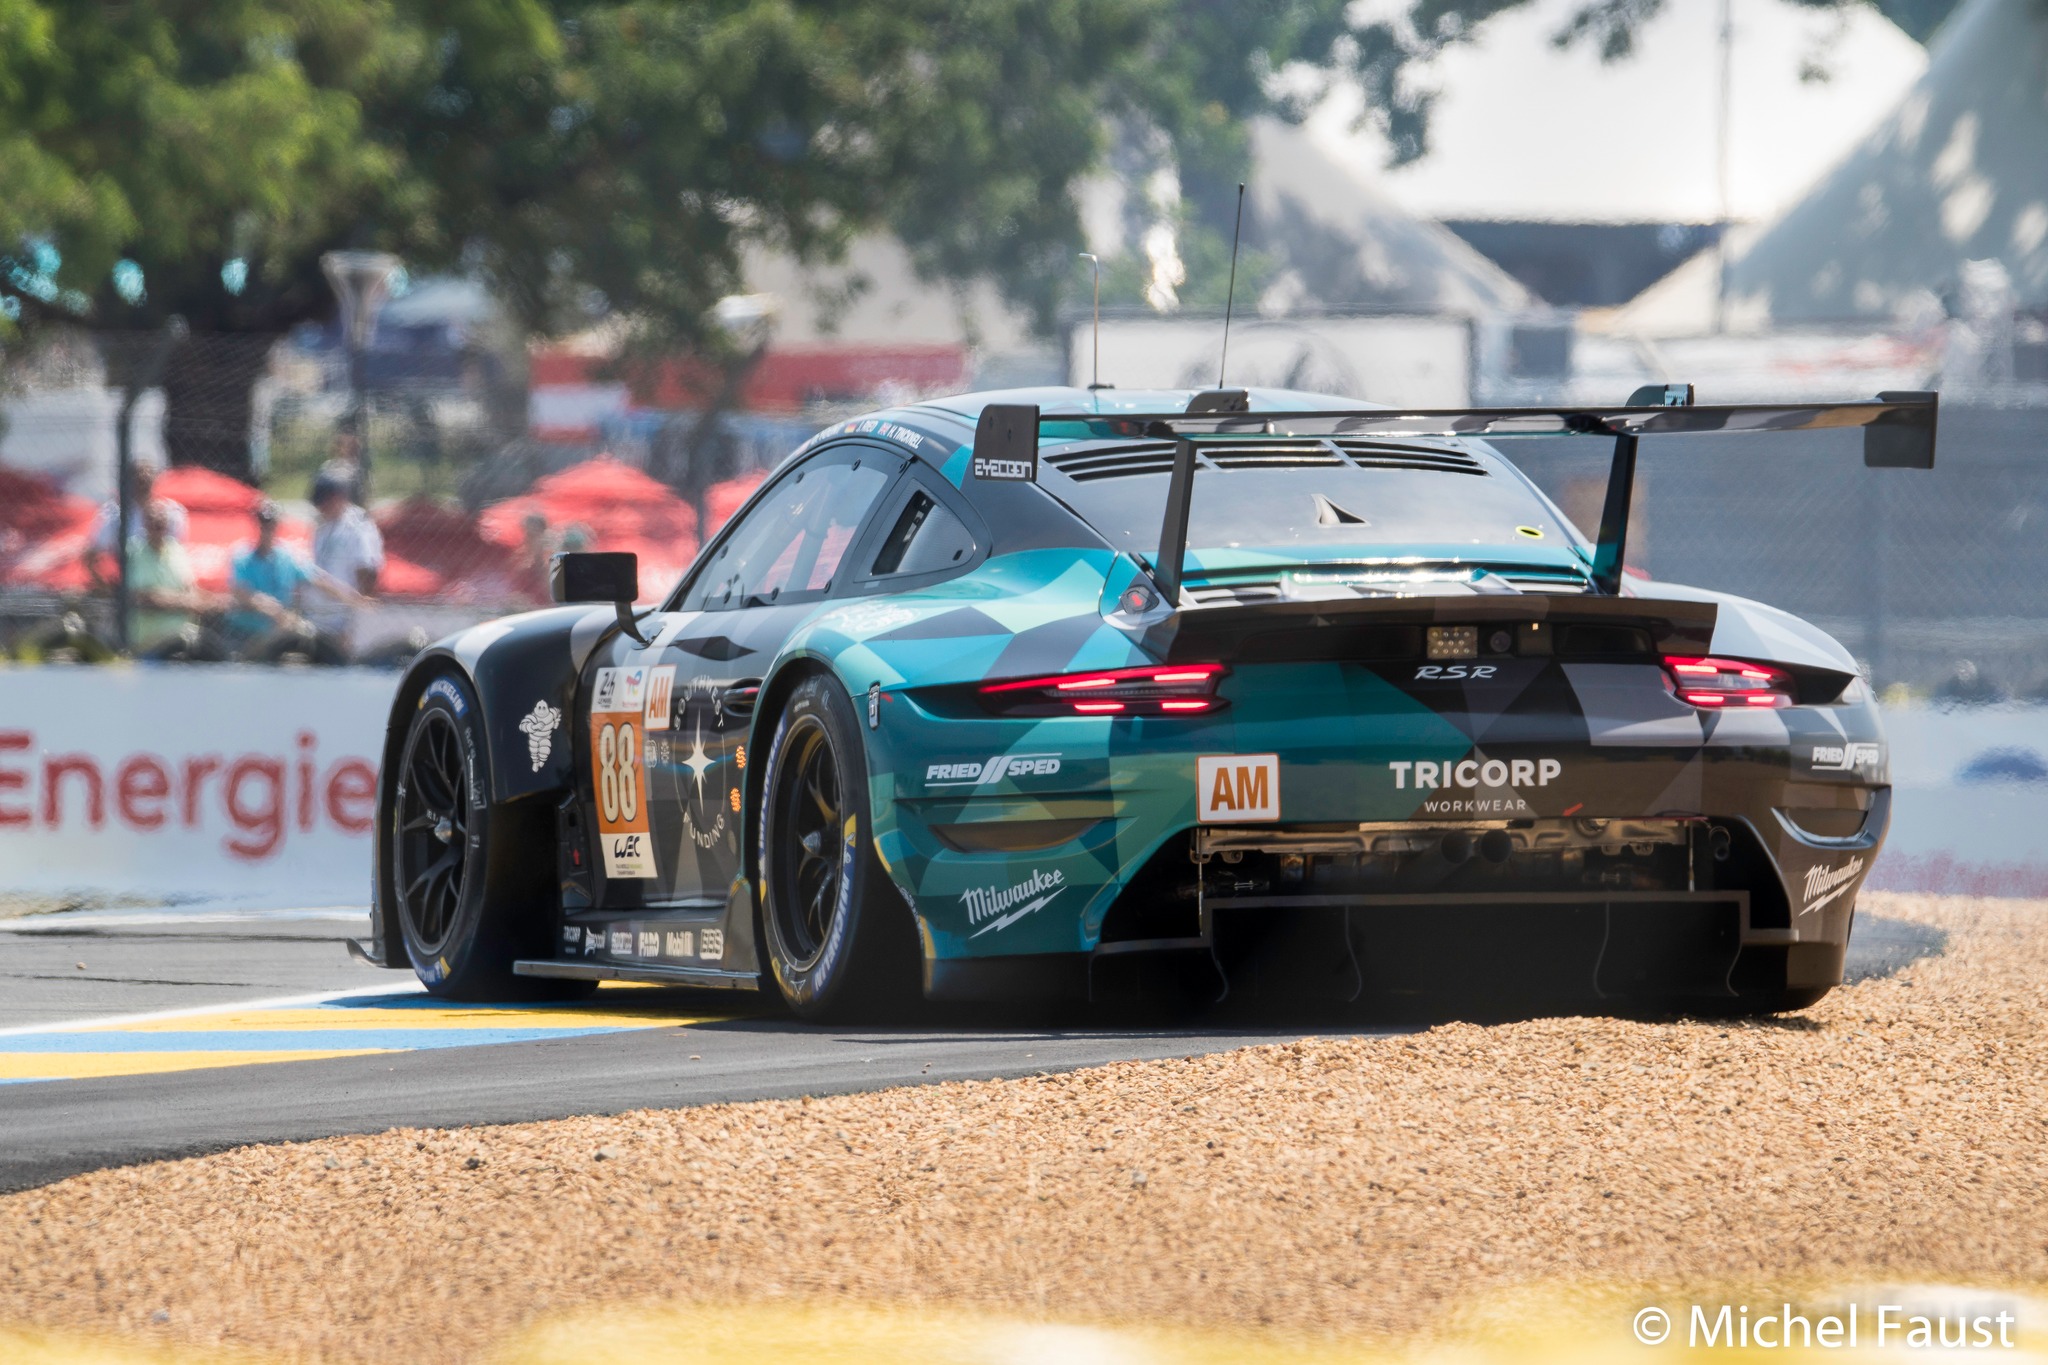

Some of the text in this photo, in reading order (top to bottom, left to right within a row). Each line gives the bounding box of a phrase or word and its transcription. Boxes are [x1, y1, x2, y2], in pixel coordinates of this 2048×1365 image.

[1413, 665, 1498, 680] RSR
[429, 678, 465, 713] MICHELIN
[648, 675, 671, 719] AM
[598, 721, 638, 823] 88
[926, 759, 1061, 779] FRIED SPED
[1388, 758, 1562, 789] TRICORP
[1812, 746, 1880, 764] FRIED SPED
[0, 726, 379, 862] Energie
[1209, 765, 1269, 812] AM
[1424, 799, 1527, 813] WORKWEAR
[614, 835, 641, 858] WEC
[682, 811, 725, 849] FUNDING
[958, 868, 1066, 925] Milwaukee
[1803, 855, 1864, 904] Milwaukee
[814, 871, 850, 992] MICHELIN
